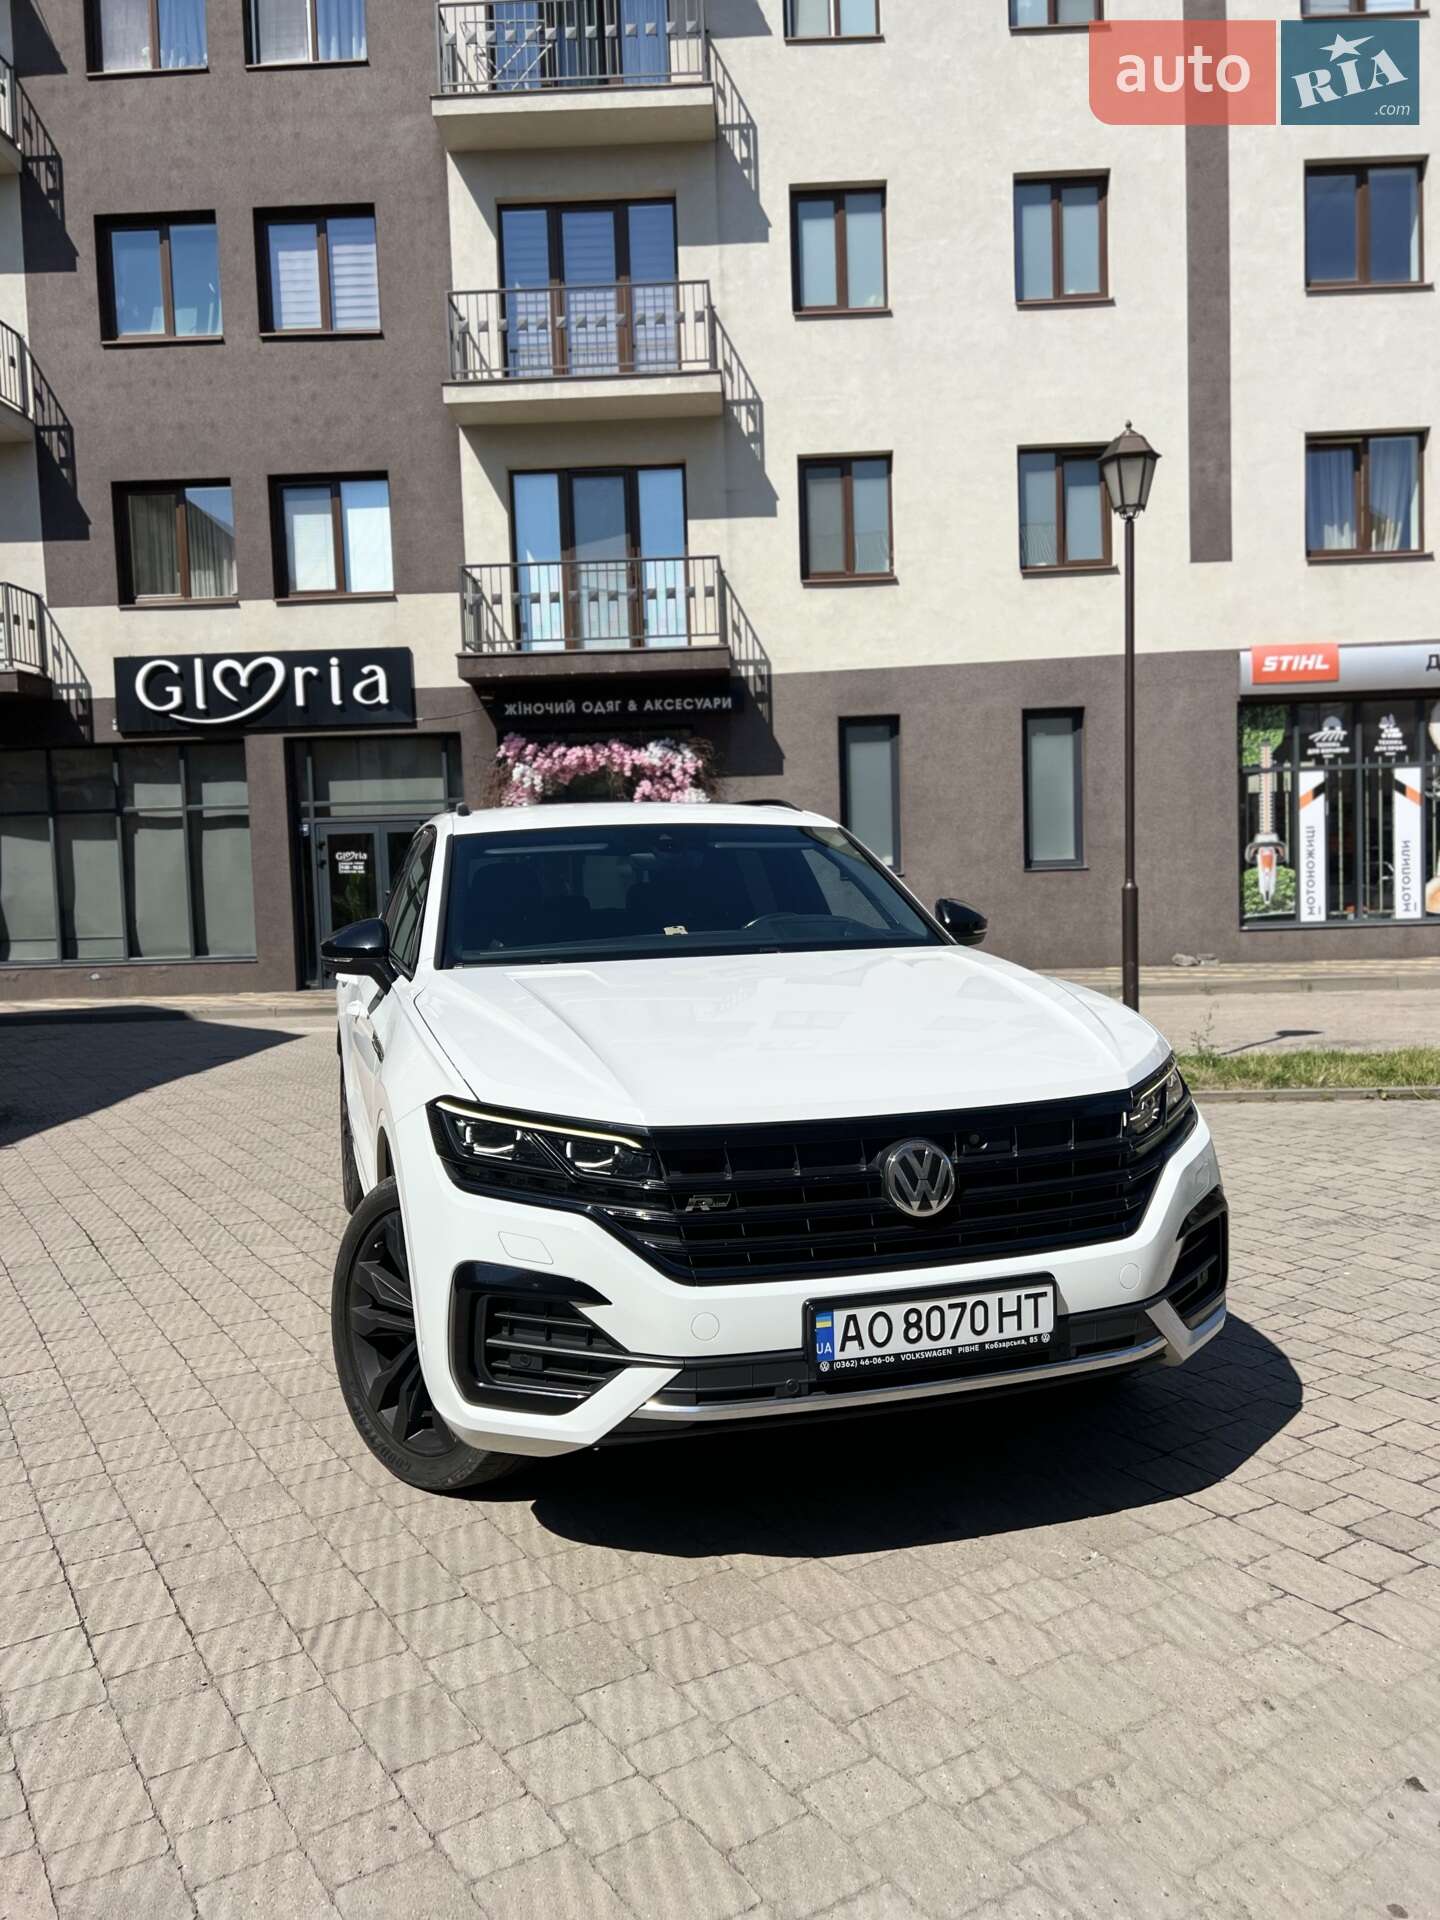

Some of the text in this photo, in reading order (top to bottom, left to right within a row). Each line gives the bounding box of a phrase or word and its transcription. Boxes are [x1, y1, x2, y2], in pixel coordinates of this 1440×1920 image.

[1261, 654, 1329, 672] STIHL
[582, 700, 621, 714] ОДЯГ
[628, 700, 637, 712] &
[643, 697, 732, 712] АКСЕСУАРИ
[1307, 825, 1316, 916] МОТОНОЖИЦІ
[1403, 839, 1412, 913] МОТОПИЛИ
[839, 1291, 1048, 1352] AO 8070 HT
[816, 1342, 832, 1354] UA
[833, 1361, 858, 1370] (0362)
[860, 1356, 895, 1367] 46-06-06
[900, 1348, 952, 1361] VOLKSWAGEN
